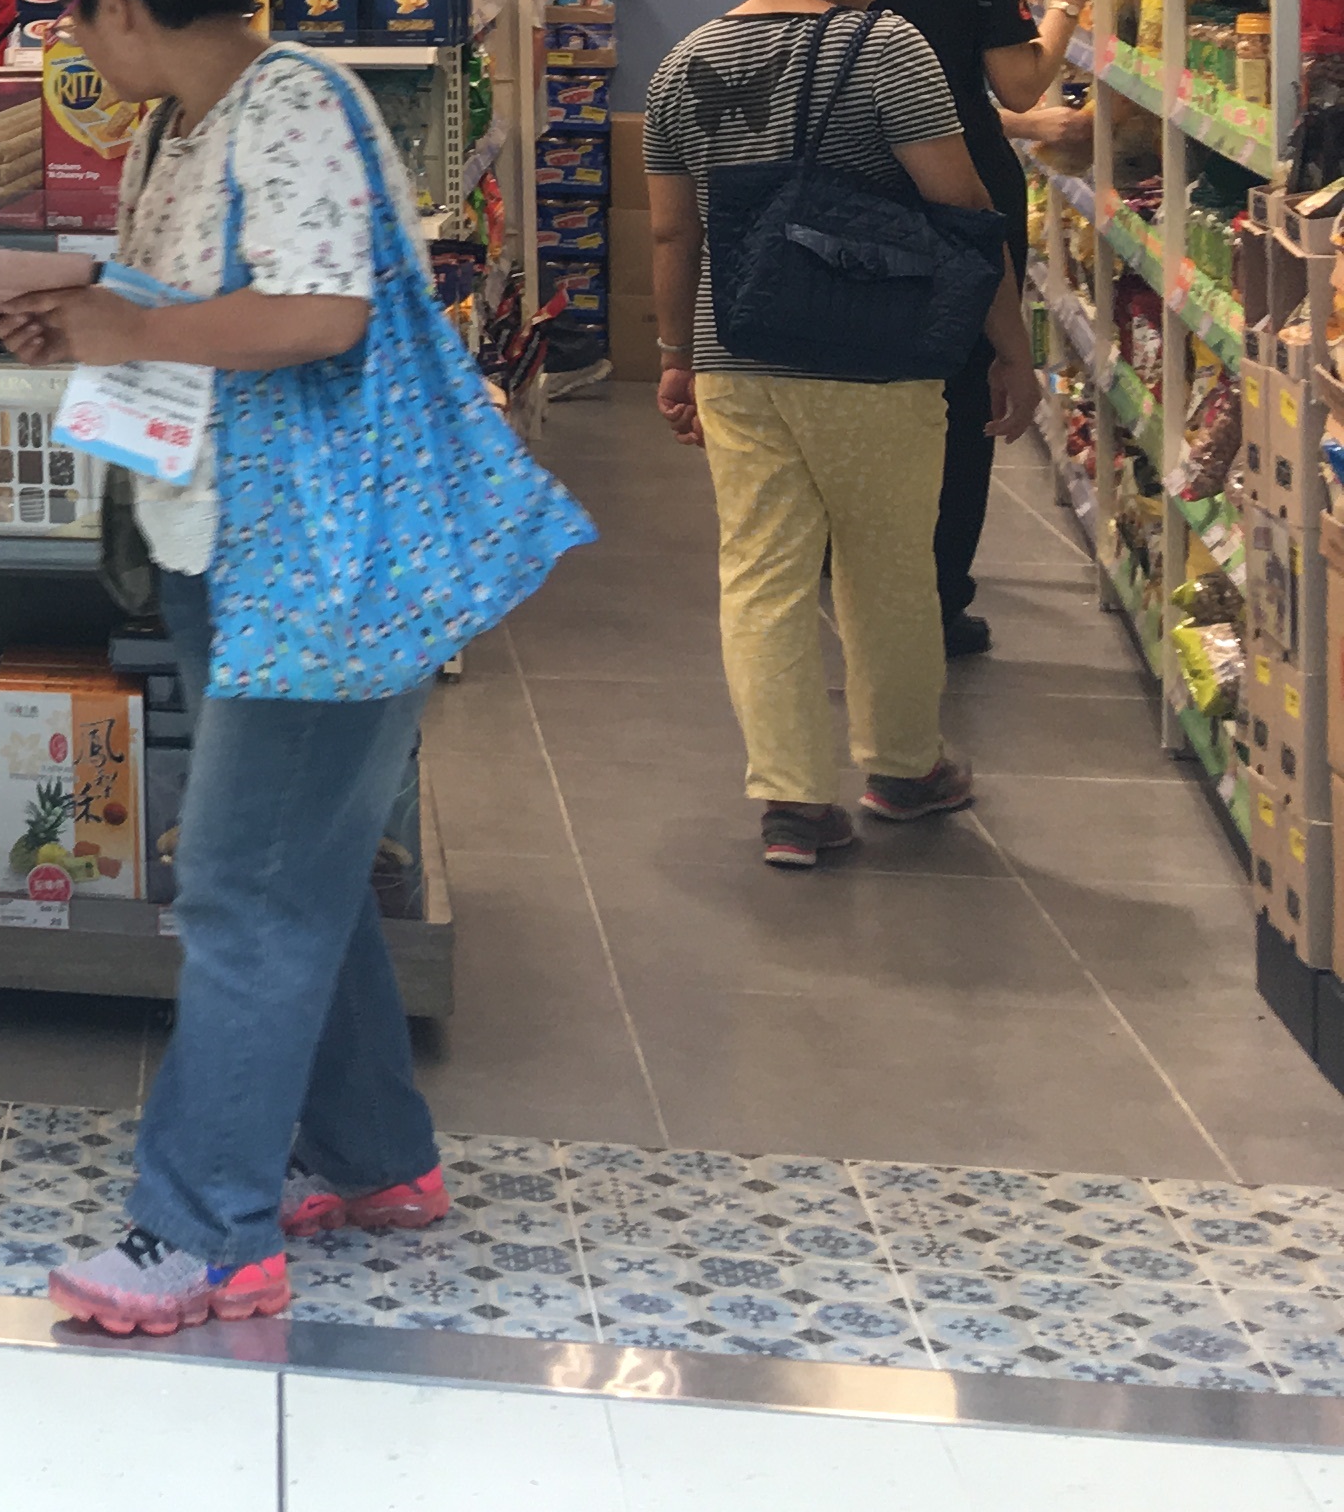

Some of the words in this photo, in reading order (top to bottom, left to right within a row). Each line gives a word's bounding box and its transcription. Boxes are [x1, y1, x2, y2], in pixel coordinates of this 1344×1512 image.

[57, 70, 102, 105] RITZ
[60, 718, 125, 825] 鳳梨酥
